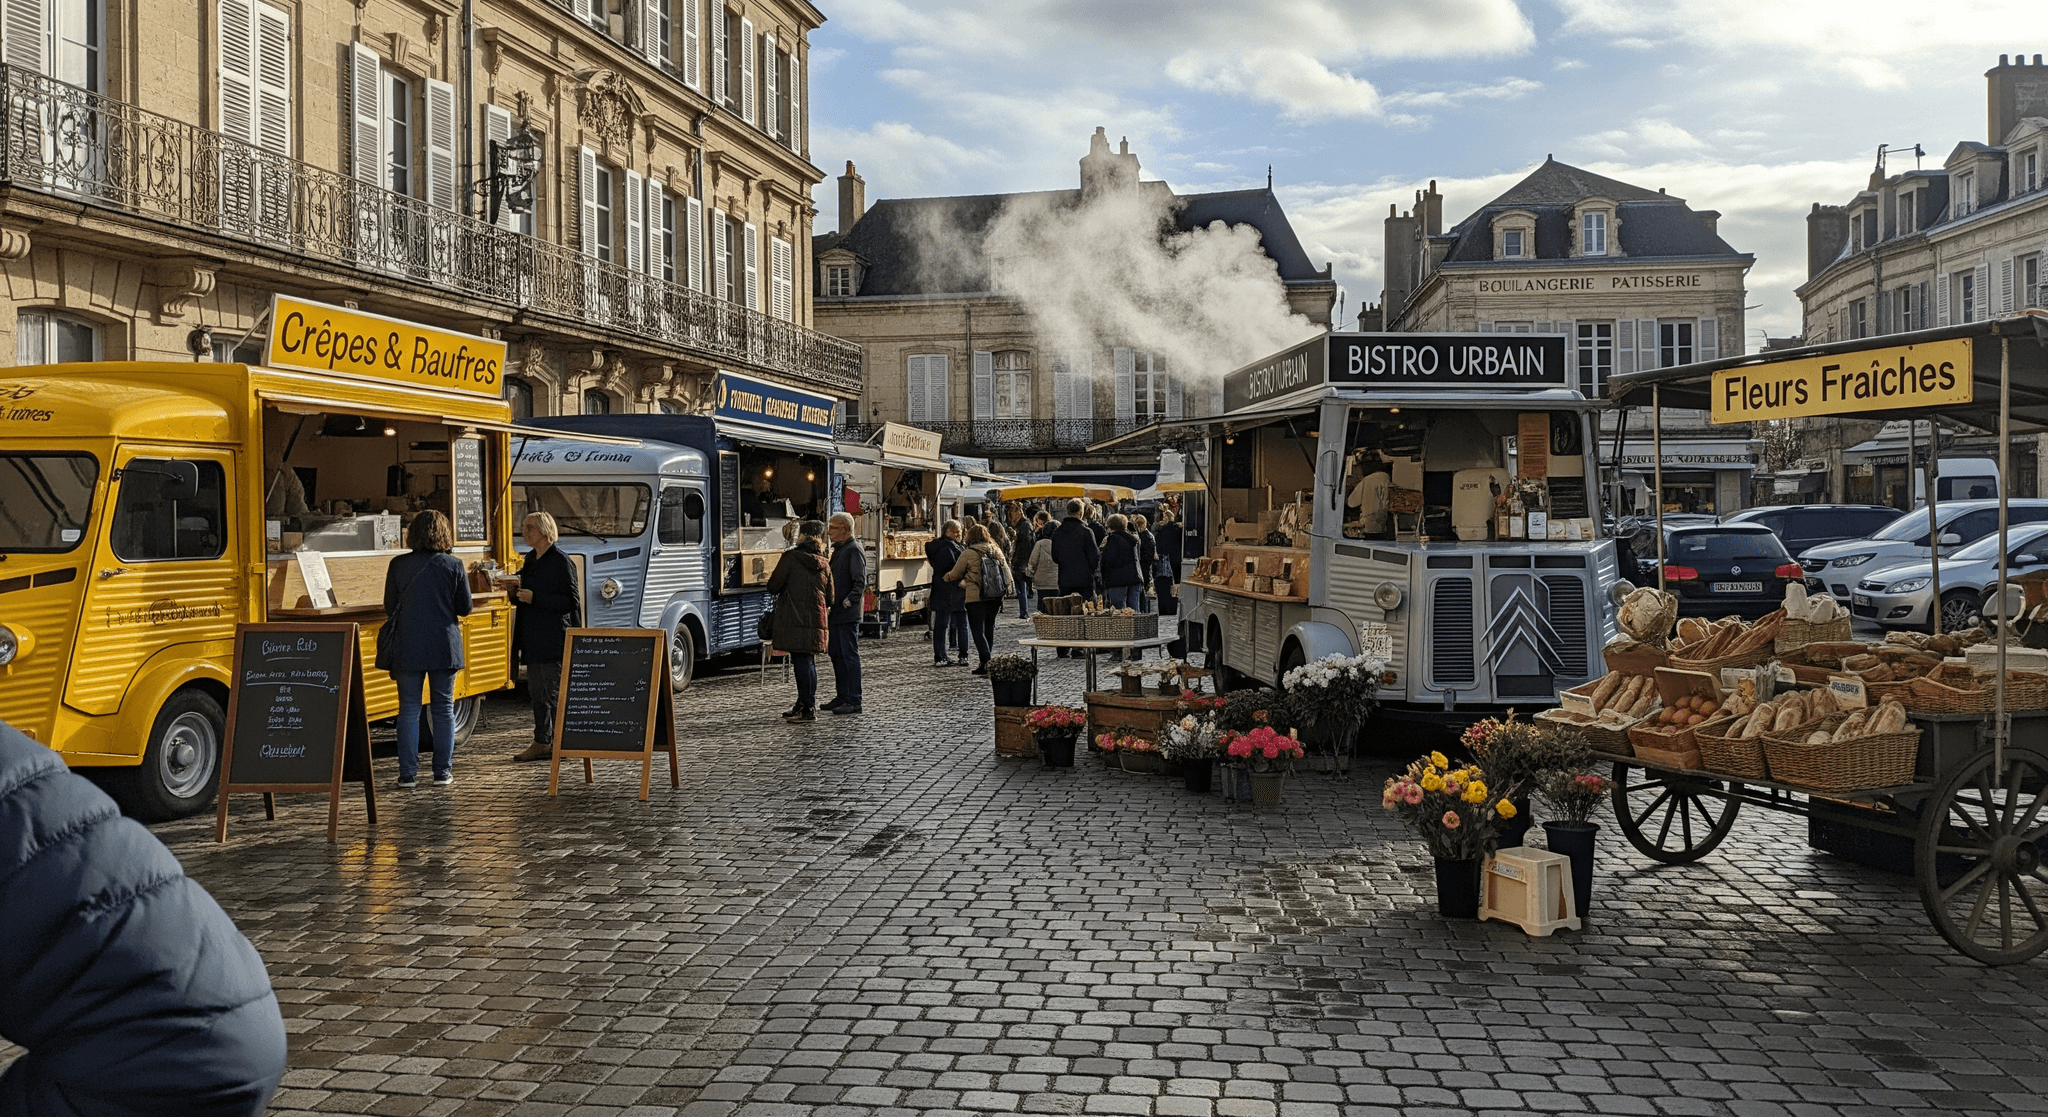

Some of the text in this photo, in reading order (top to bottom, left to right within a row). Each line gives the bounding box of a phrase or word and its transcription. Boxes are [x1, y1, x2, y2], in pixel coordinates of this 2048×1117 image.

[1612, 274, 1702, 289] PATISSERIE
[281, 311, 378, 370] Crêpes
[383, 331, 402, 370] &
[1348, 345, 1544, 376] BISTRO URBAIN
[1725, 356, 1956, 411] Fleurs Fraîches
